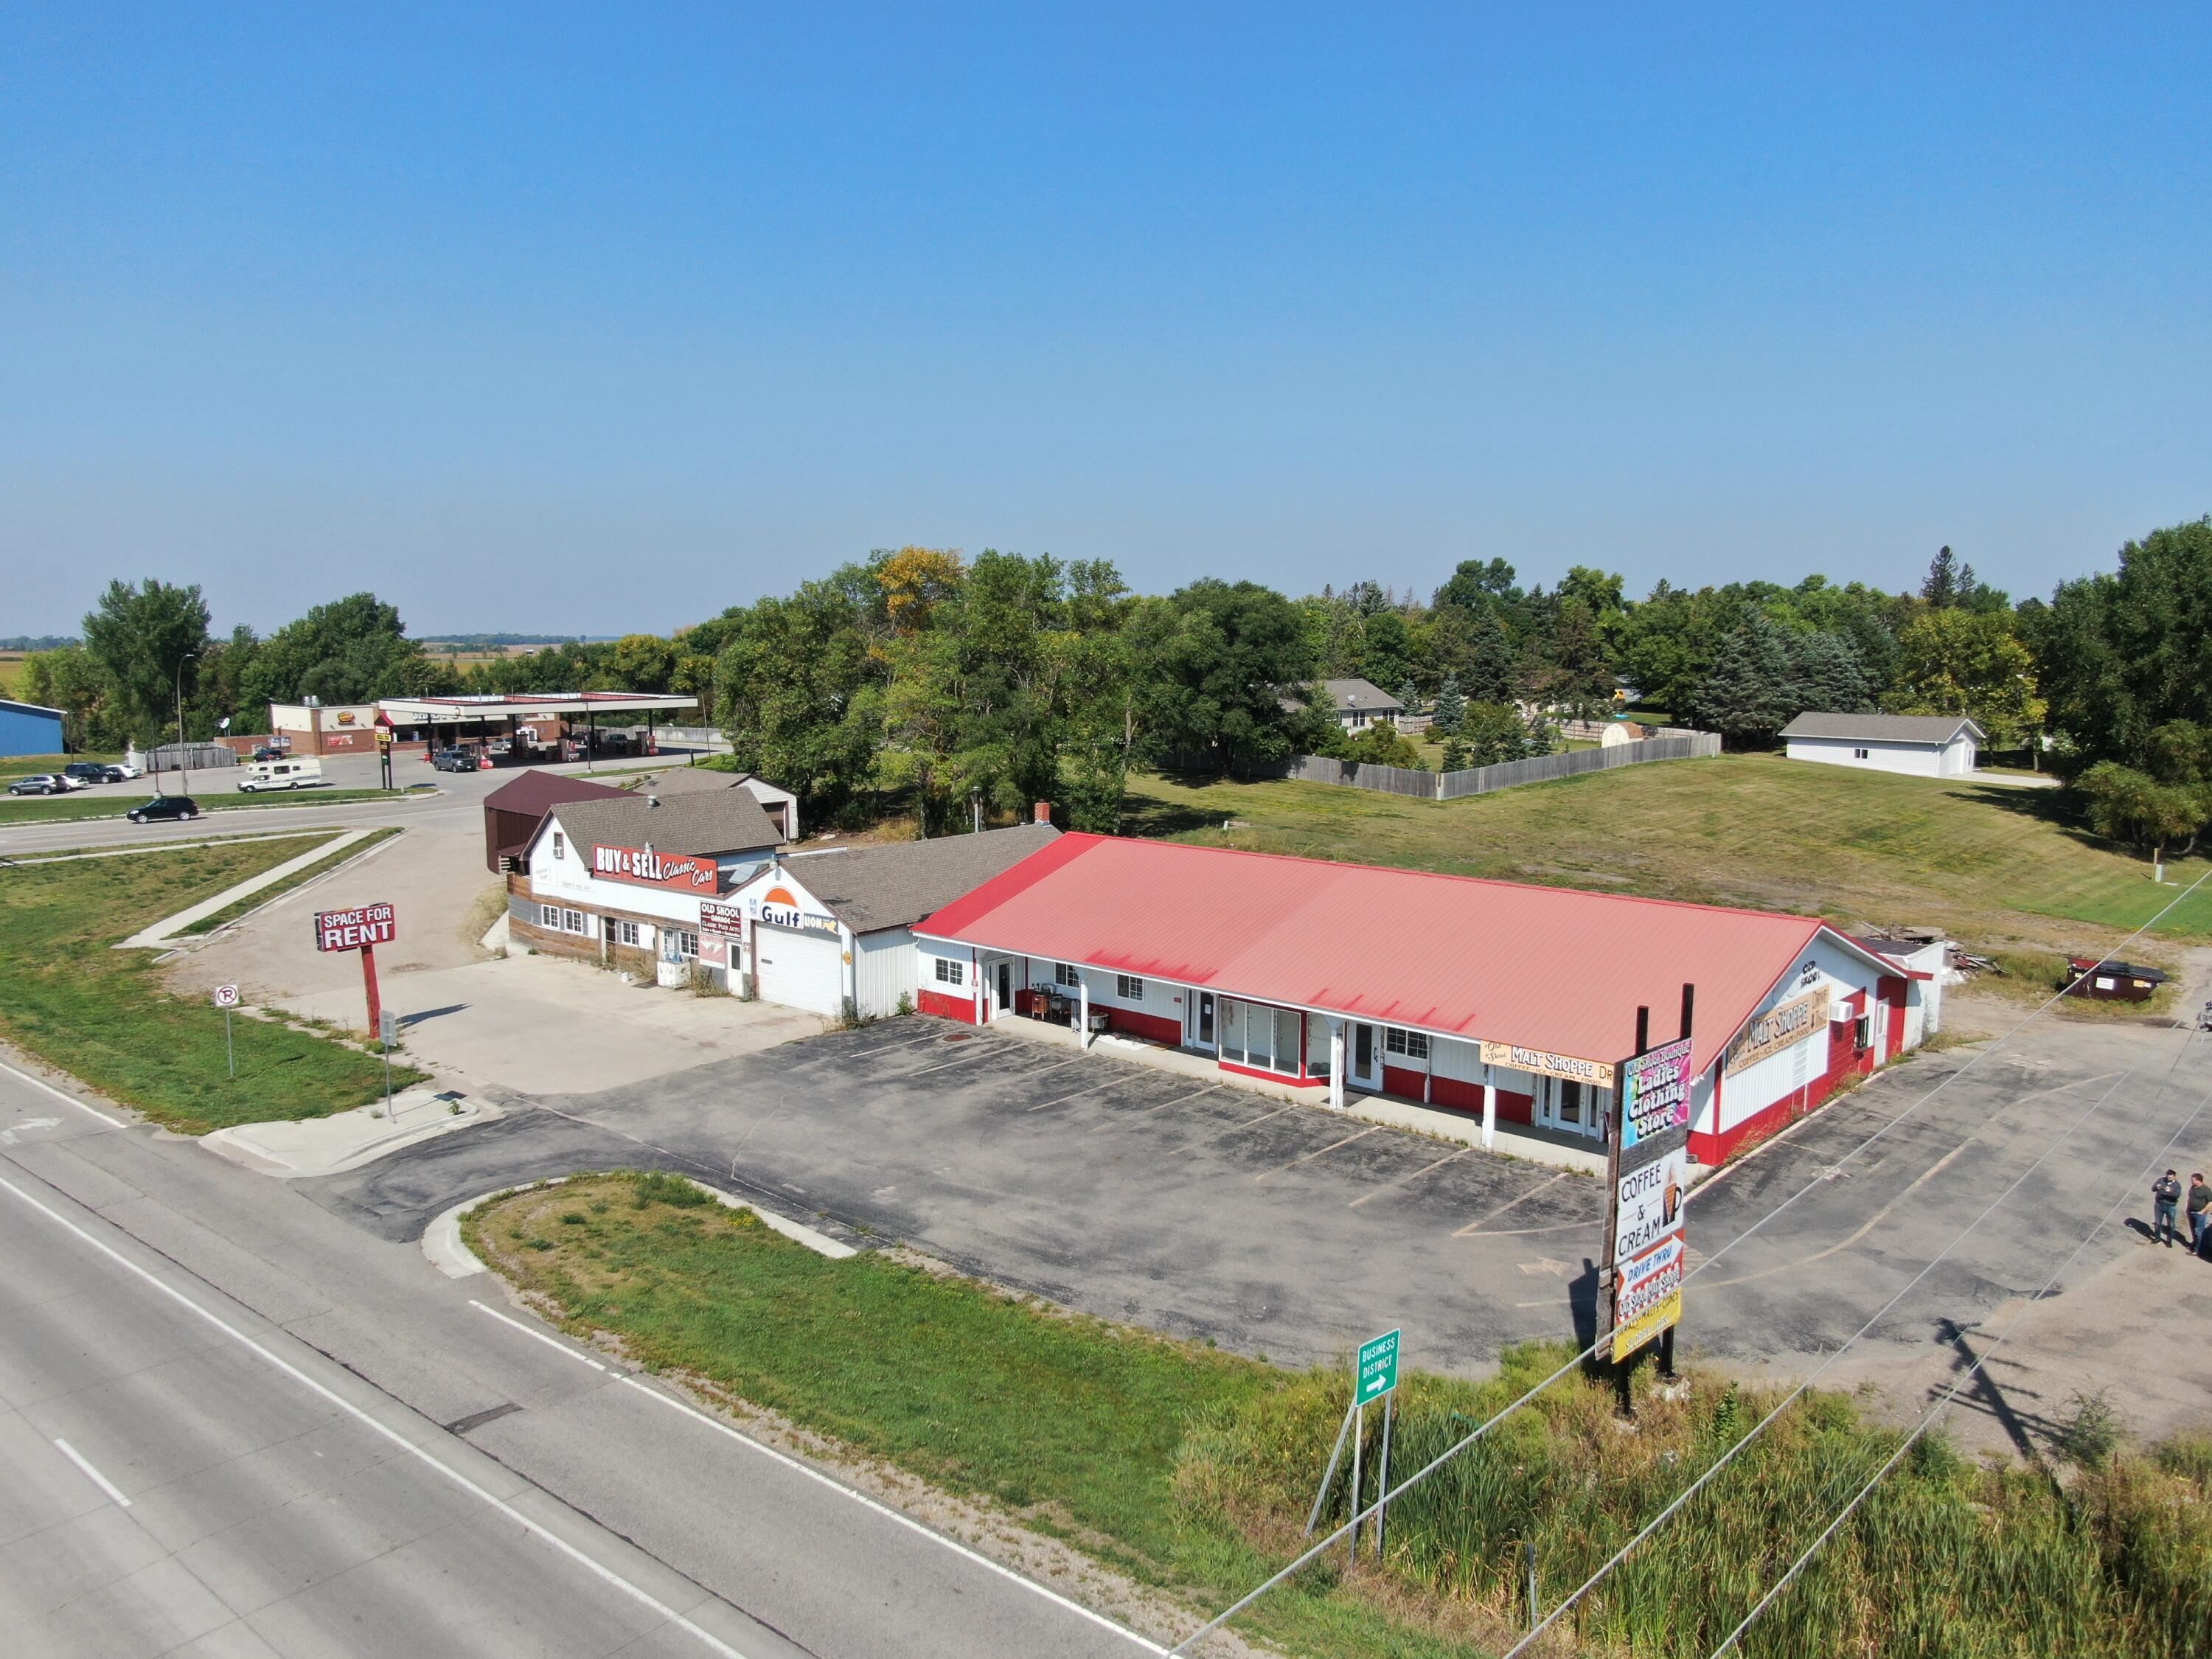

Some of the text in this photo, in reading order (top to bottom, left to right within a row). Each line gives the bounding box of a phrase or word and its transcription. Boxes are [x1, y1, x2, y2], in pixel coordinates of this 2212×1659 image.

[596, 847, 663, 880] BUY & SELL
[663, 860, 696, 880] Classic
[692, 869, 713, 886] Cars
[324, 907, 392, 928] SPACE FOR
[701, 903, 715, 914] OLD
[716, 906, 740, 918] SKOOL
[762, 905, 800, 927] Gulf
[324, 921, 392, 949] RENT
[1747, 1000, 1809, 1053] MALT SHOPPE
[1512, 1046, 1543, 1067] MALT
[1545, 1053, 1593, 1077] SHOPPE
[1739, 1026, 1810, 1068] COFFEE ICE CREAM FOOD
[1505, 1062, 1529, 1071] COFFEE
[1550, 1071, 1576, 1080] CREAM
[1581, 1077, 1601, 1085] FOOD
[1637, 1065, 1680, 1096] Ladies
[1628, 1082, 1685, 1121] Clothing
[1637, 1107, 1674, 1138] Store
[1621, 1164, 1661, 1203] COFFEE
[1637, 1203, 1646, 1221] &
[1618, 1216, 1661, 1256] CREAM
[1627, 1244, 1673, 1283] DRIVE THRU
[1362, 1337, 1395, 1363] BUSINESS
[1363, 1354, 1393, 1380] DISTRICT
